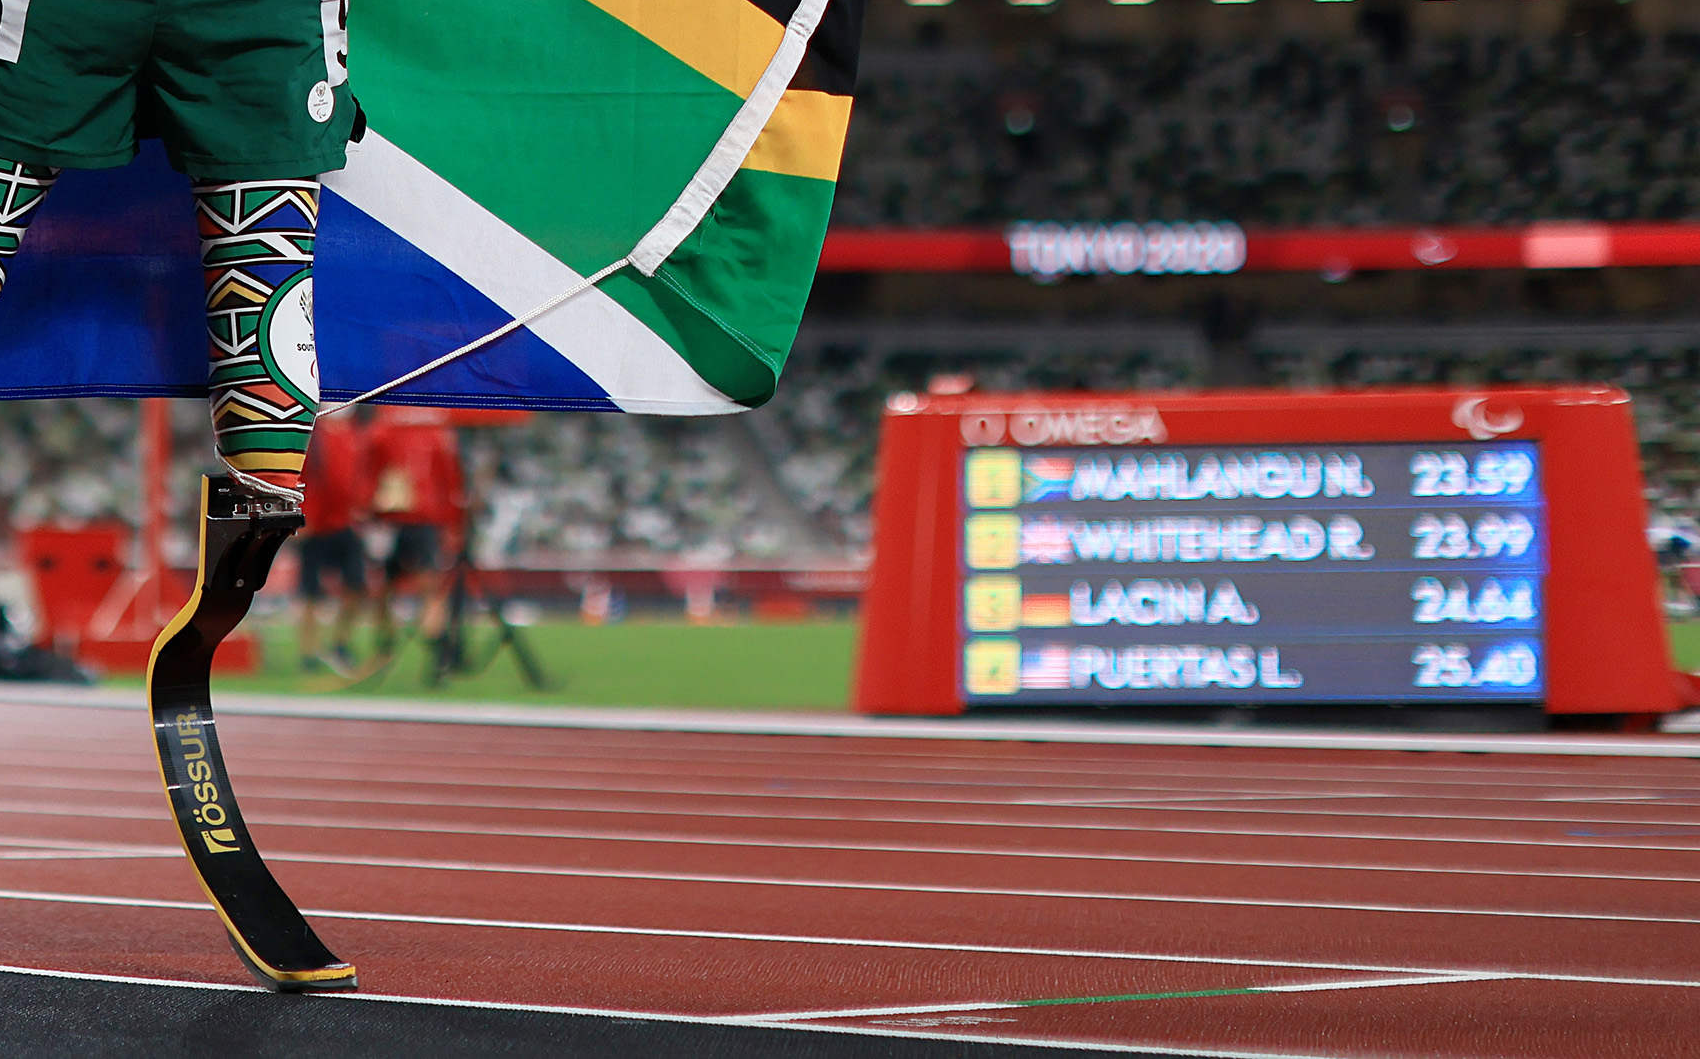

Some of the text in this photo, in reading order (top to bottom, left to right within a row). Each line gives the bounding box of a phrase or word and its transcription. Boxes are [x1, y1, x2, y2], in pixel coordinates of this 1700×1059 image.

[1010, 410, 1168, 446] OMEGA
[1068, 451, 1323, 501] MAHLANGU
[1409, 450, 1534, 497] 23.59
[1068, 515, 1326, 563] WHITEHEAD
[1409, 512, 1536, 560] 23.99
[1069, 644, 1258, 690] PUERTAS
[1410, 642, 1538, 688] 25.40
